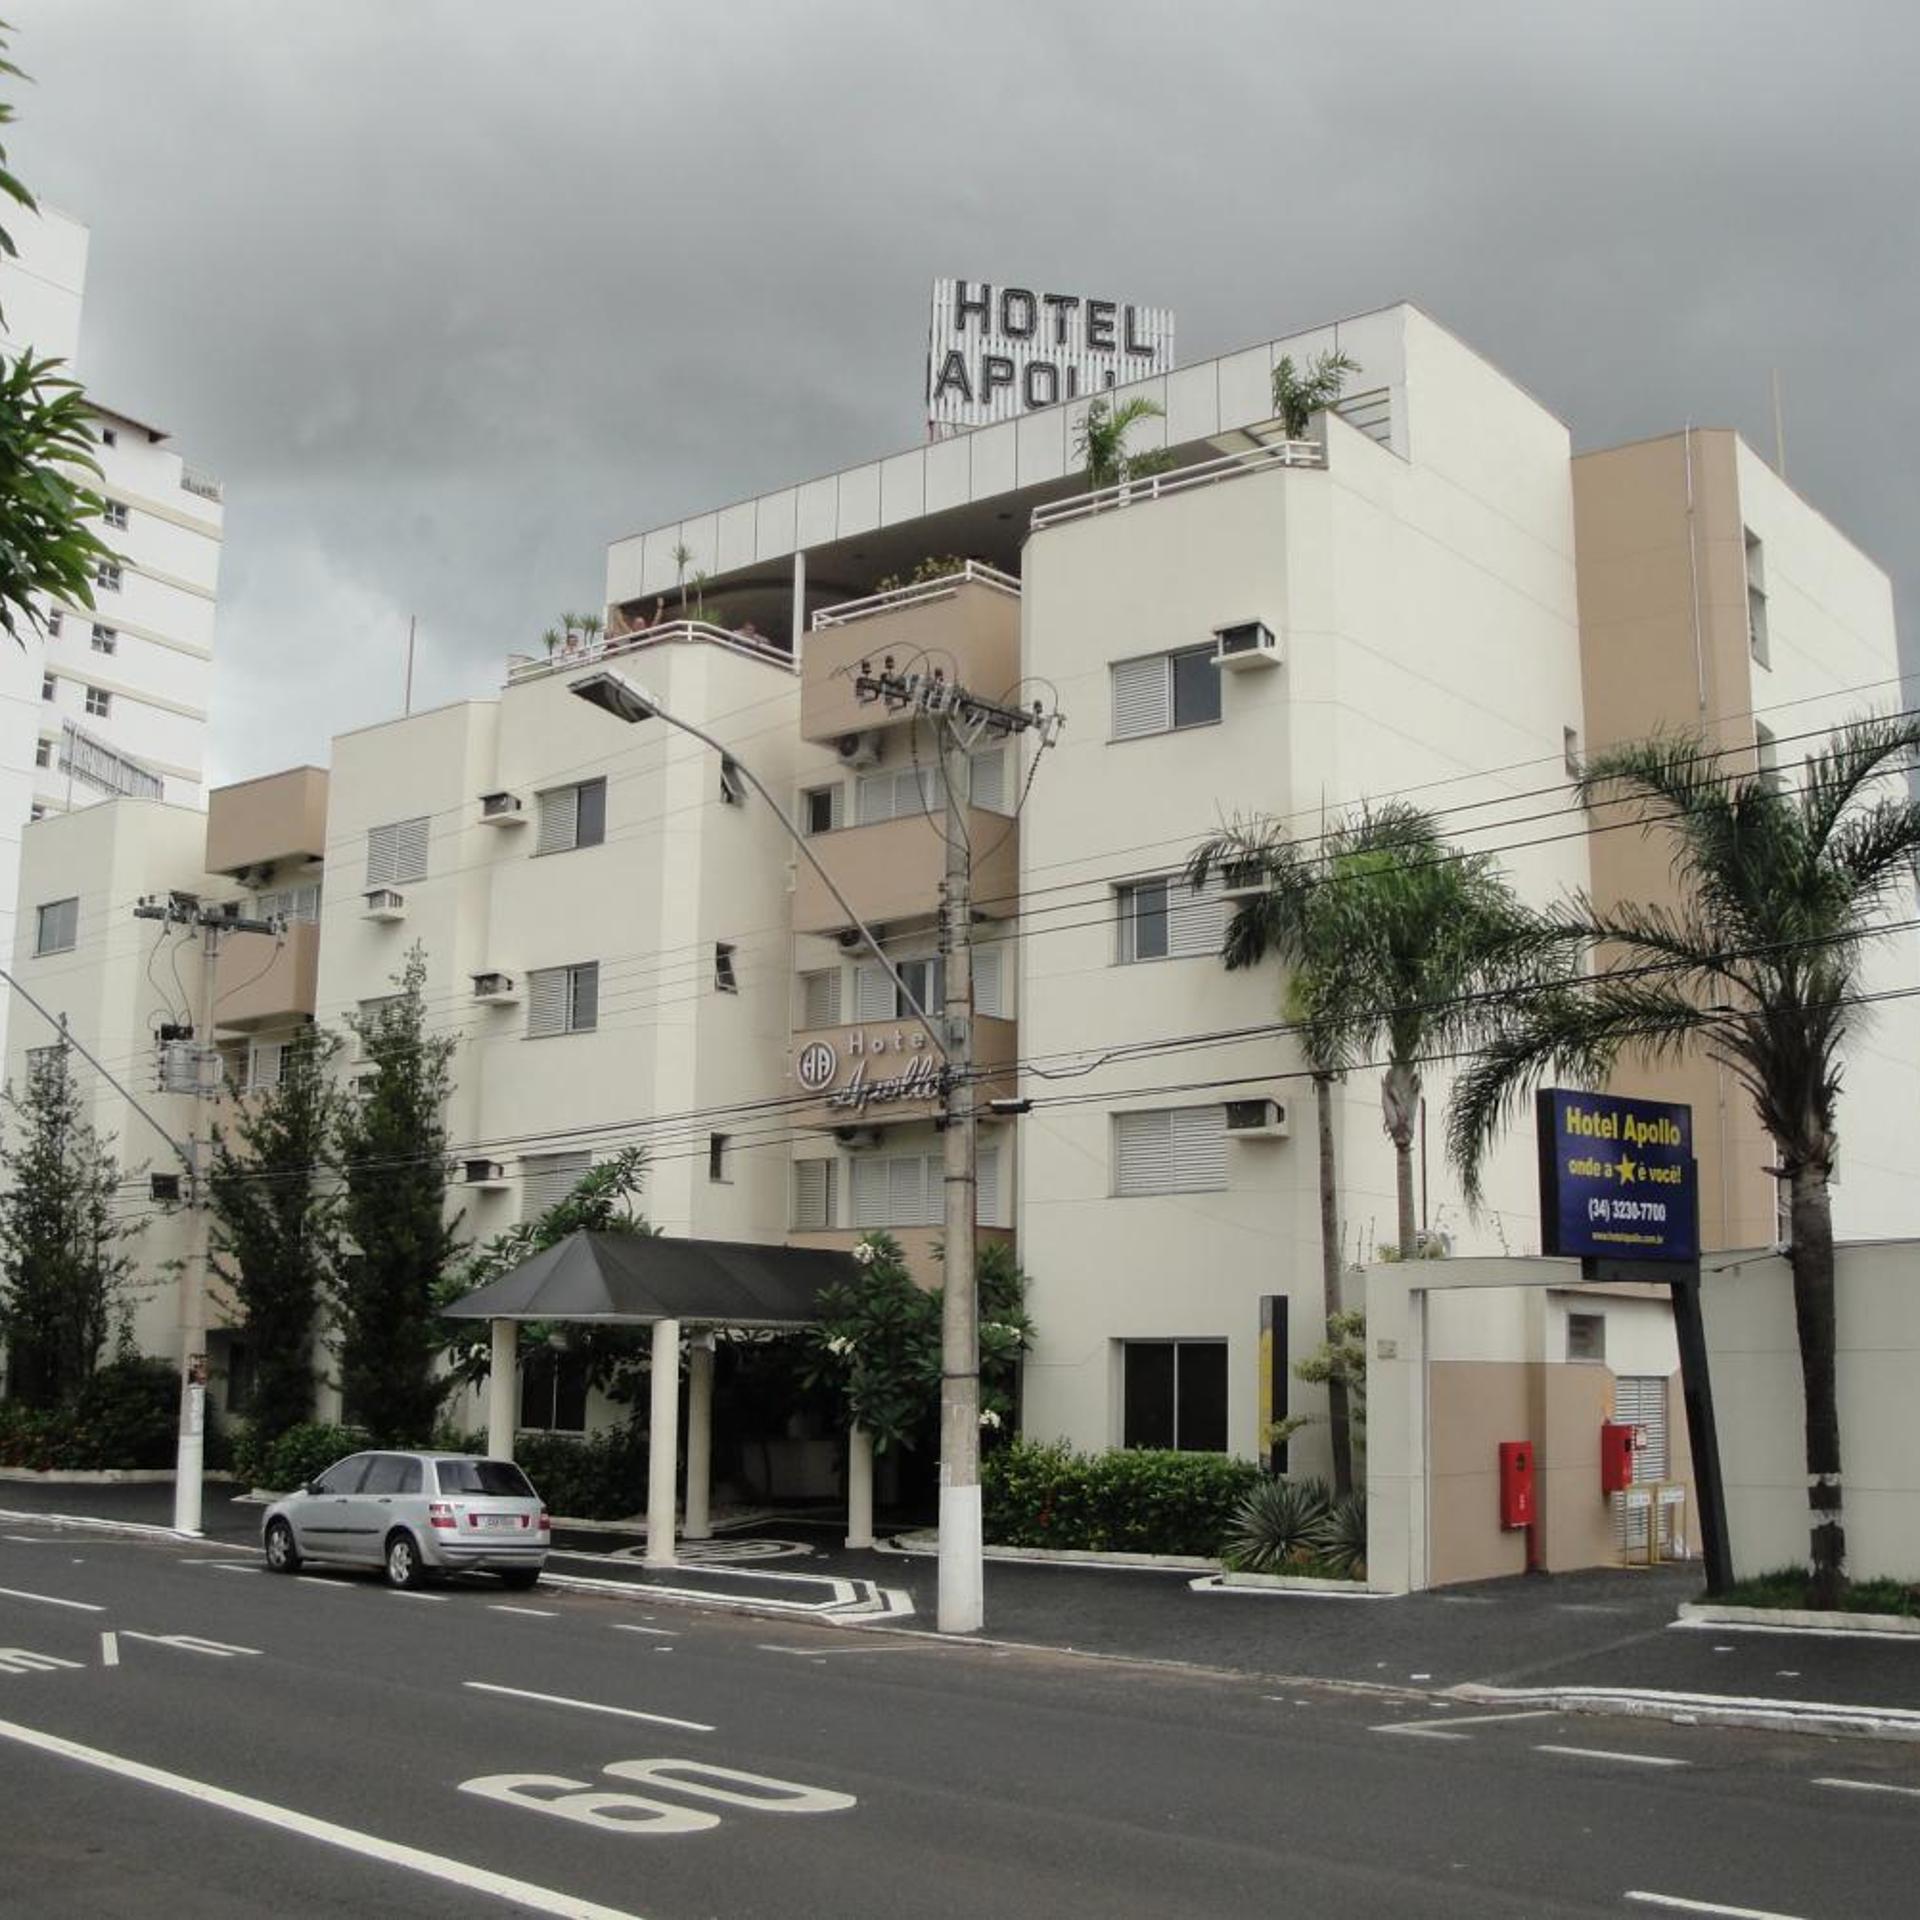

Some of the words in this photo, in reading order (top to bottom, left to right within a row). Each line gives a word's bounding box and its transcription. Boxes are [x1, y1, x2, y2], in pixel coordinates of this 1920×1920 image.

[955, 280, 1155, 356] HOTEL
[1566, 1106, 1618, 1139] Hotel
[1624, 1114, 1681, 1148] Apollo
[1568, 1157, 1601, 1177] onde
[1604, 1163, 1613, 1178] a
[1588, 1198, 1610, 1223] (34)
[1612, 1200, 1667, 1222] 3230-7700
[457, 1758, 857, 1834] 60
